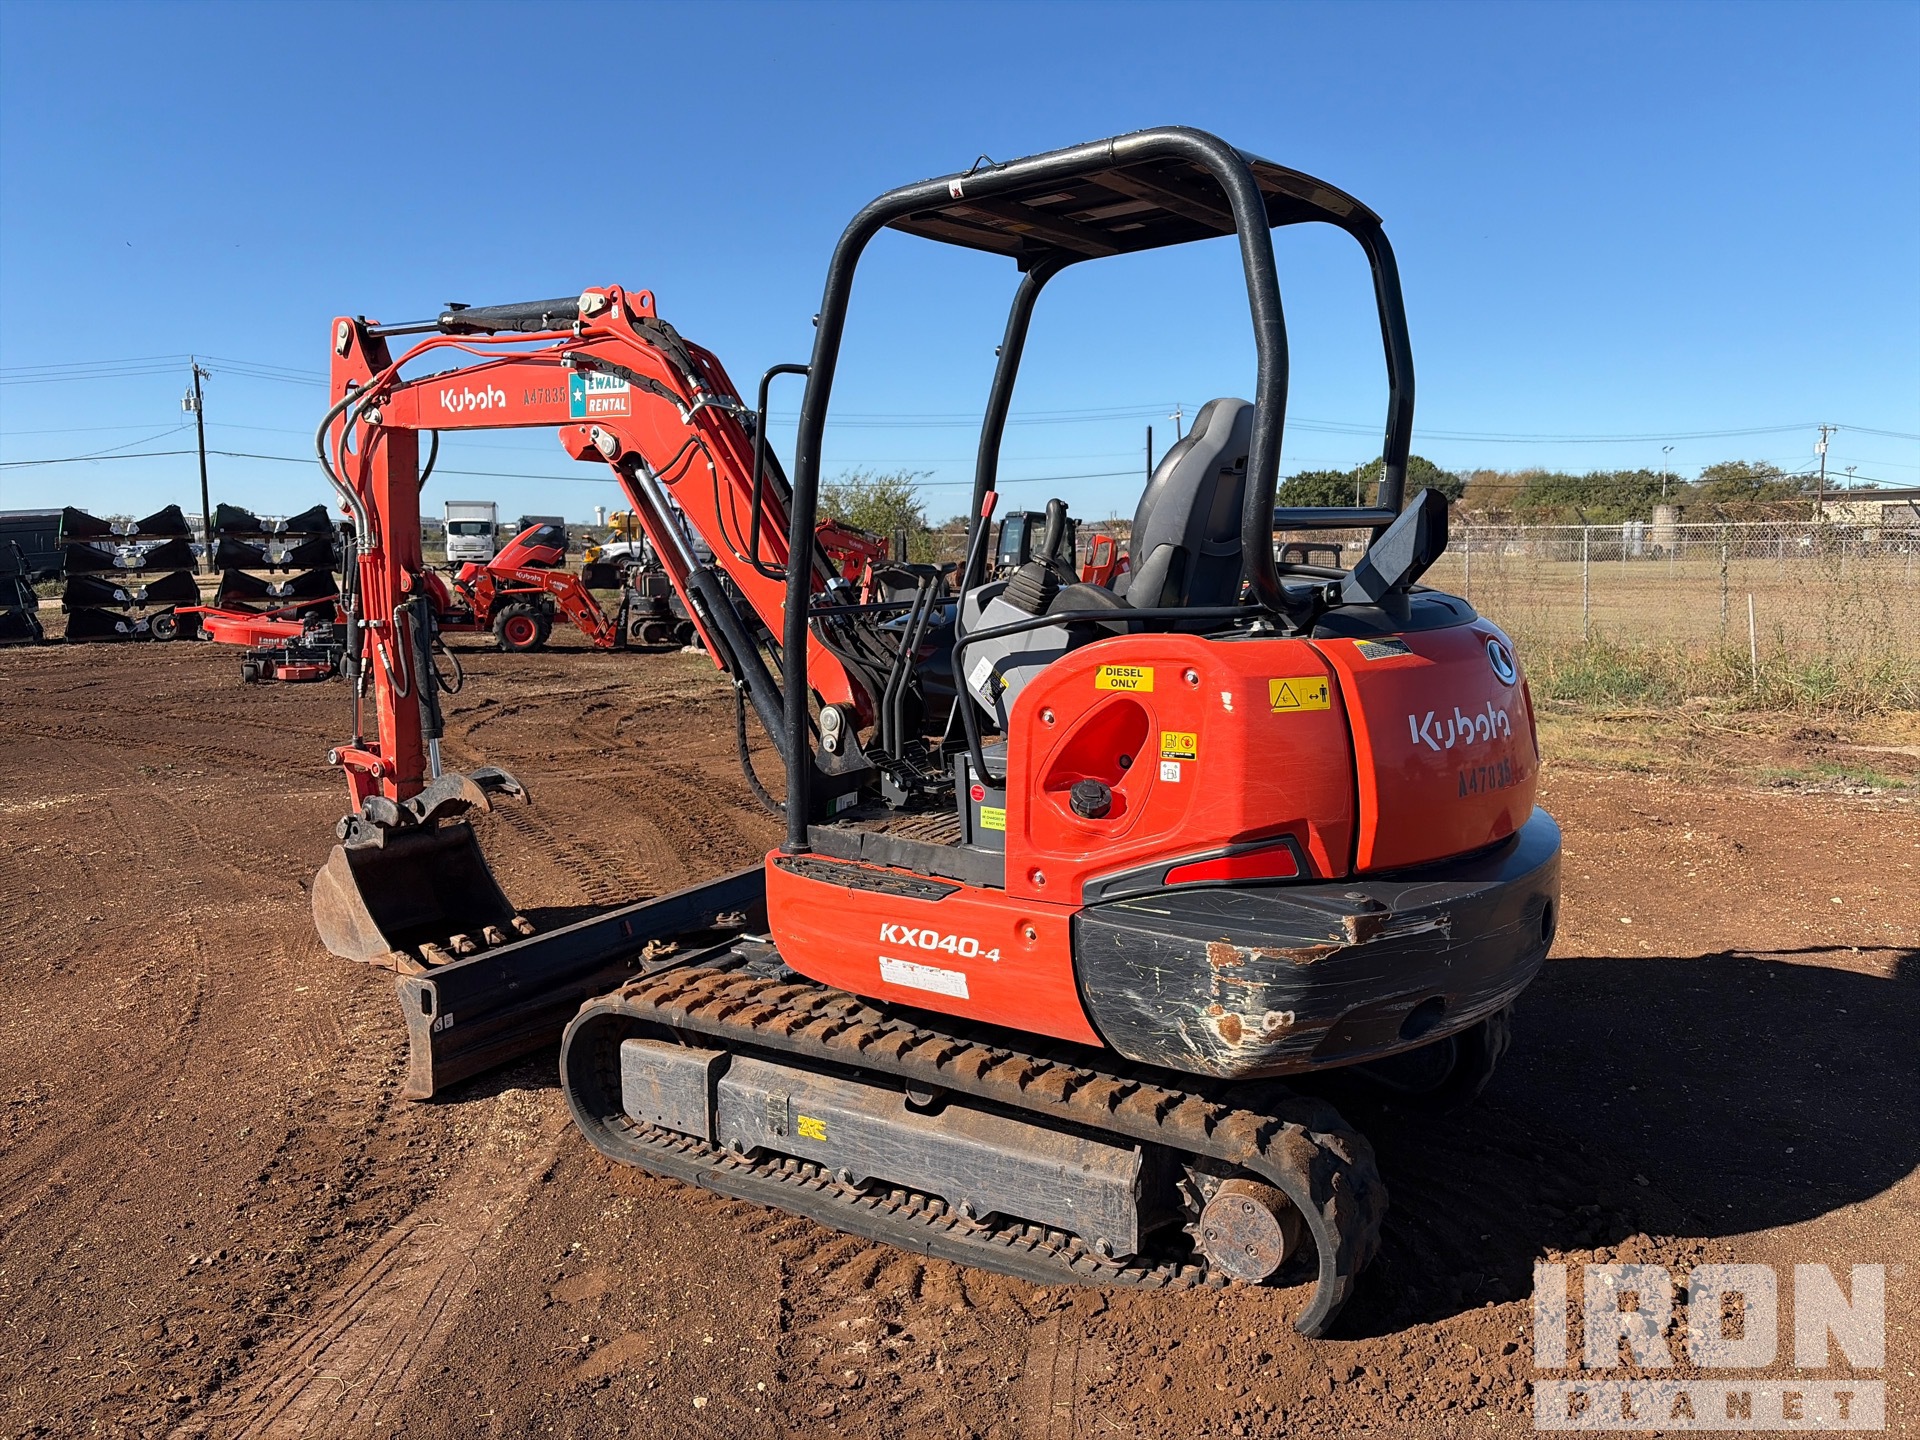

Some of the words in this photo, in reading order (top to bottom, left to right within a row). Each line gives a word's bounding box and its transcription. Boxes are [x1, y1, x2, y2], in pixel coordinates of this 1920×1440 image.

[588, 376, 625, 390] EWALD
[440, 384, 506, 412] Kubota
[523, 387, 566, 406] A47835
[589, 398, 626, 412] RENTAL
[515, 571, 542, 582] Kubota
[1105, 667, 1144, 678] DIESEL
[1110, 678, 1138, 689] ONLY
[1408, 701, 1511, 752] Kubota
[1458, 758, 1512, 798] A47835
[879, 922, 1000, 962] KX040-4
